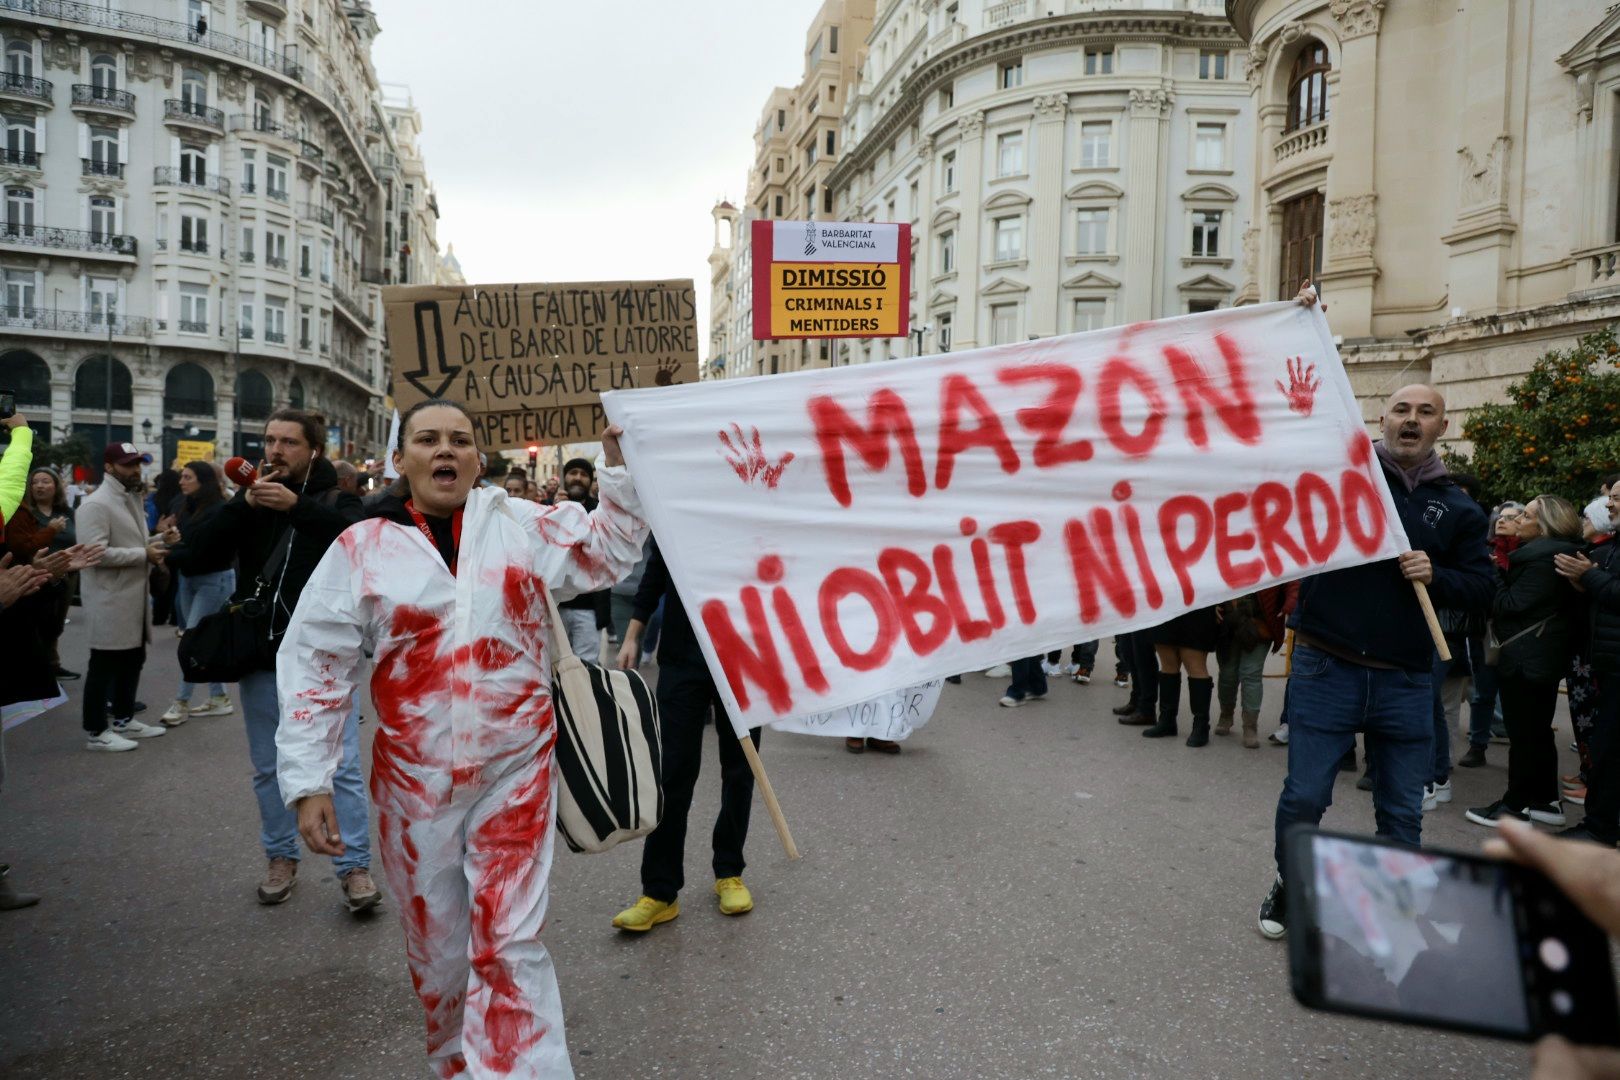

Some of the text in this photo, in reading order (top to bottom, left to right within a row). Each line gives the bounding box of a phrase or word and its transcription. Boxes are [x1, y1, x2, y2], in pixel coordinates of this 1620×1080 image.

[822, 229, 873, 239] BARBARITAT
[822, 240, 876, 249] VALENCIANA
[782, 264, 886, 287] DIMISSIÓ
[453, 284, 520, 329] AQUÍ
[532, 288, 606, 327] FALTEN
[785, 297, 883, 311] CRIMINALS I
[790, 318, 879, 331] MENTIDERS
[460, 331, 504, 365] DEL
[510, 328, 575, 358] BARRI
[583, 328, 608, 355] DE
[465, 361, 634, 400] A CAUSA DE LA
[474, 403, 581, 446] MPETÈNCIA
